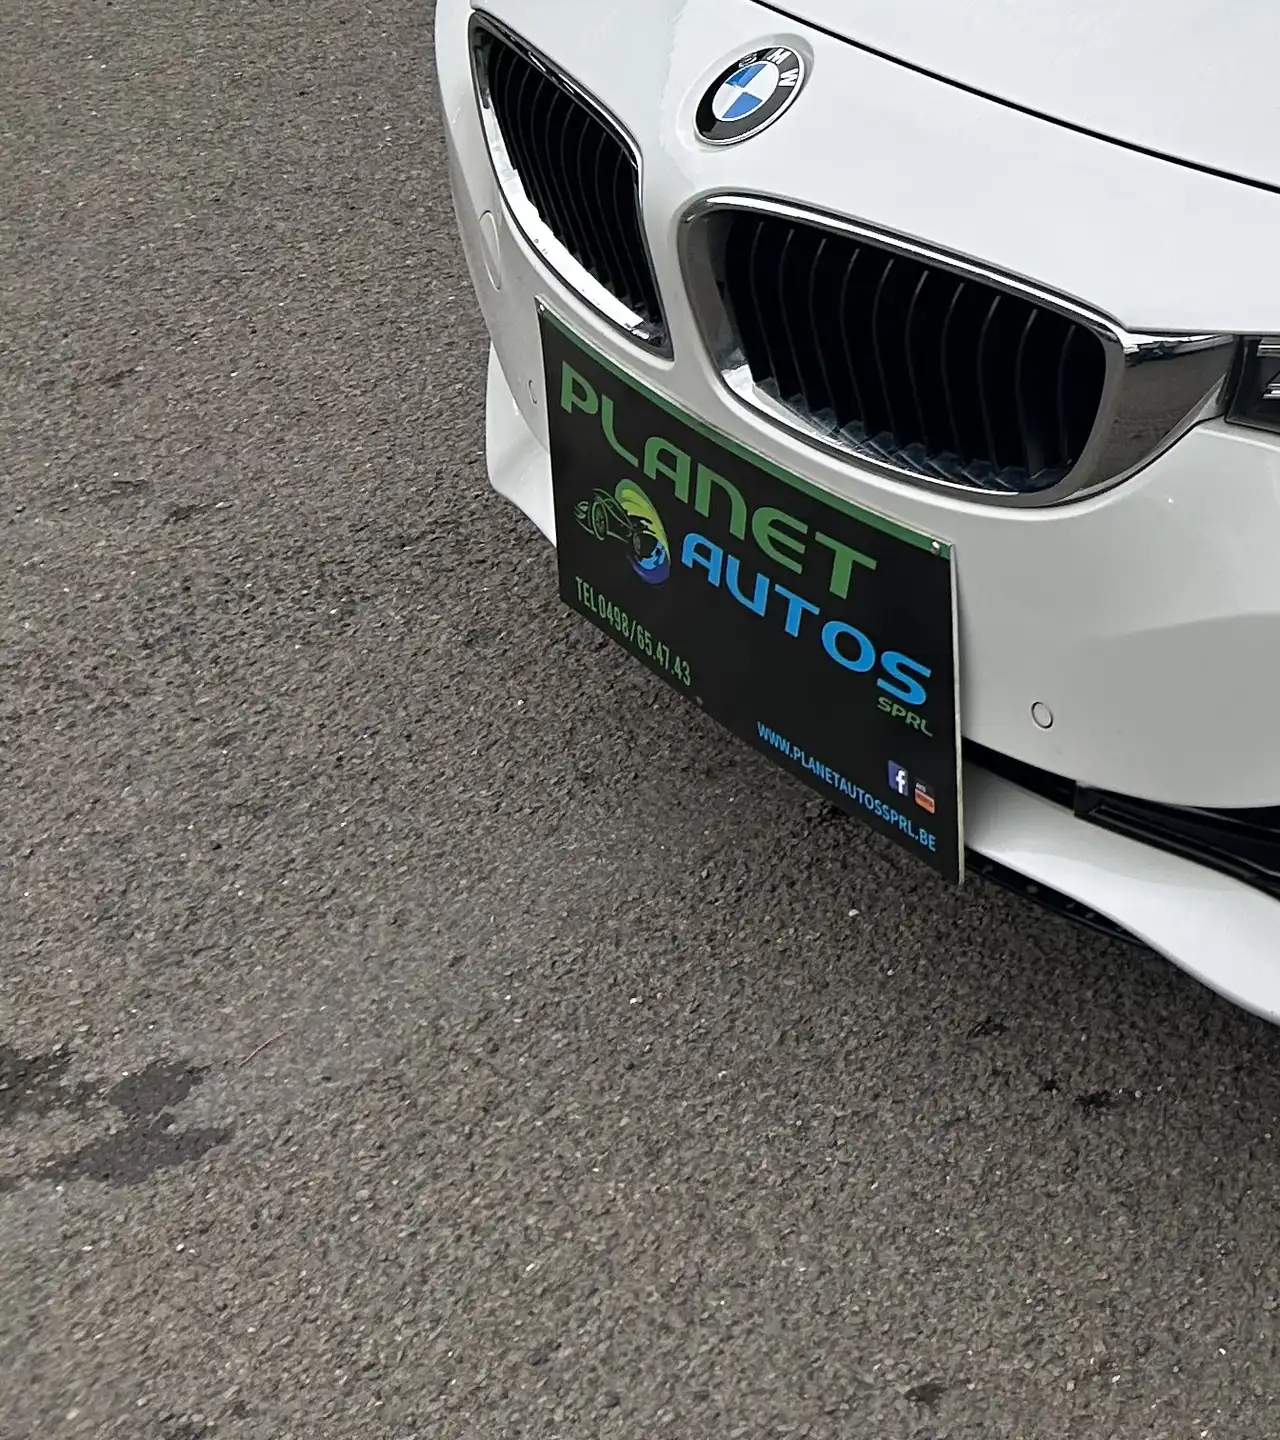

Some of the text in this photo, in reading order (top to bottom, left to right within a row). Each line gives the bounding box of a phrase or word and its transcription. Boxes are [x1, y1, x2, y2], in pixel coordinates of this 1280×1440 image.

[560, 361, 877, 600] PLANET
[575, 576, 691, 686] TEL 0498/65.47.43
[681, 532, 932, 706] AUTOS
[876, 696, 933, 738] SPRL
[757, 720, 936, 852] WWW.PLANETAUTOSSPRL.BE
